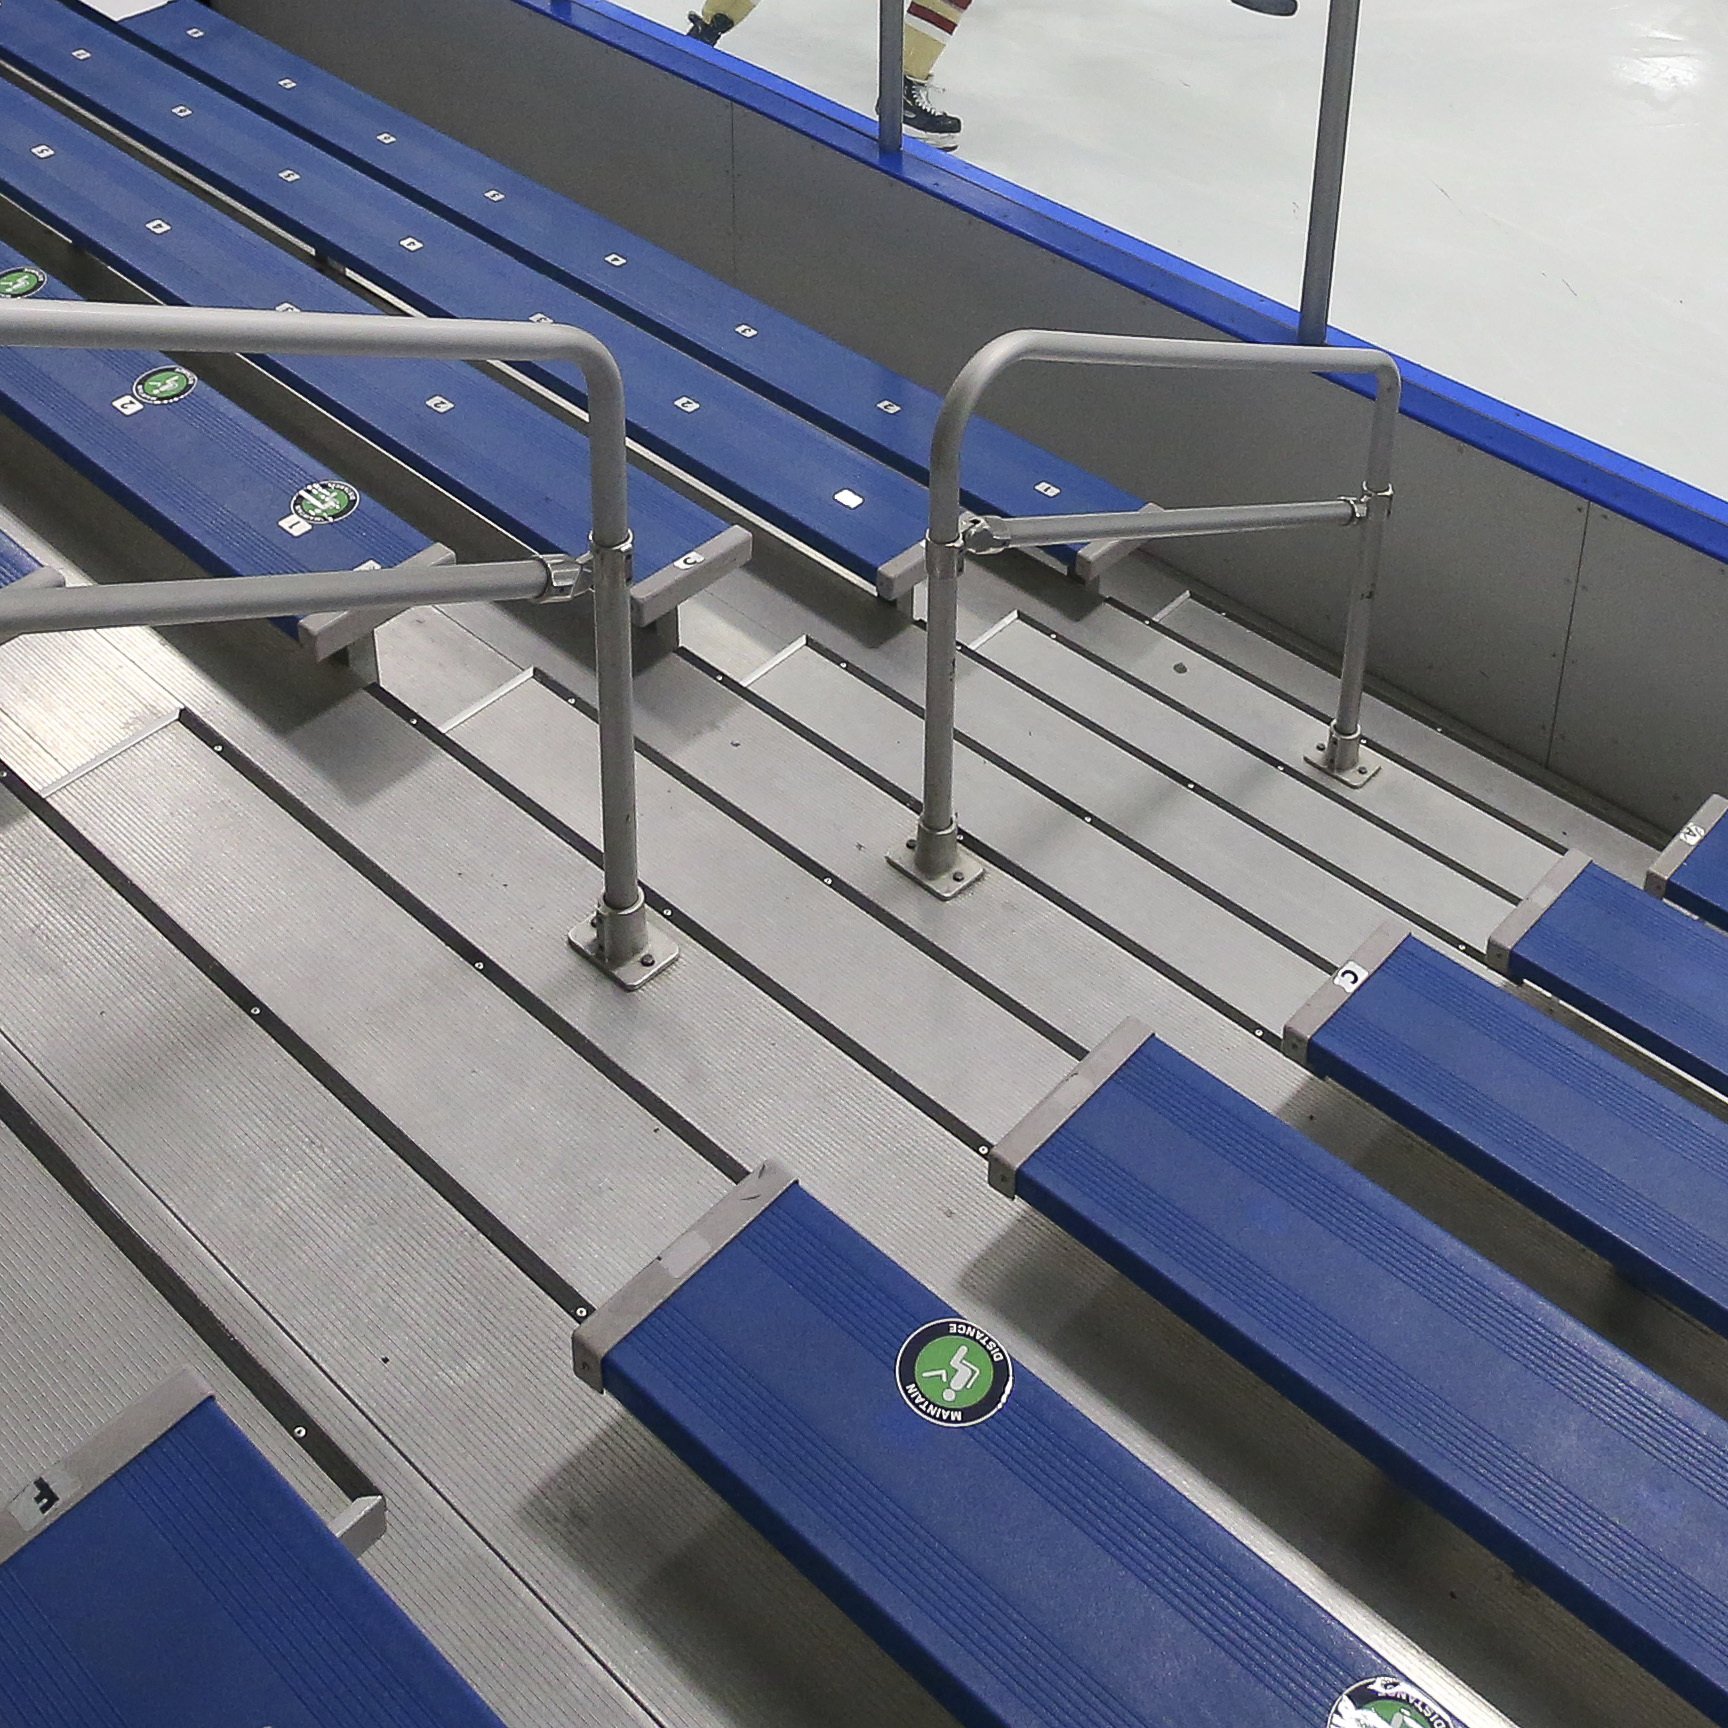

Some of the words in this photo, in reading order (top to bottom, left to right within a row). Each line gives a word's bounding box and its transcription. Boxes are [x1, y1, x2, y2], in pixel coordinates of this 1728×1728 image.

[1341, 969, 1359, 985] C
[948, 1322, 1005, 1363] DISTANCE
[905, 1382, 964, 1422] MAINTAIN
[33, 1476, 60, 1515] F
